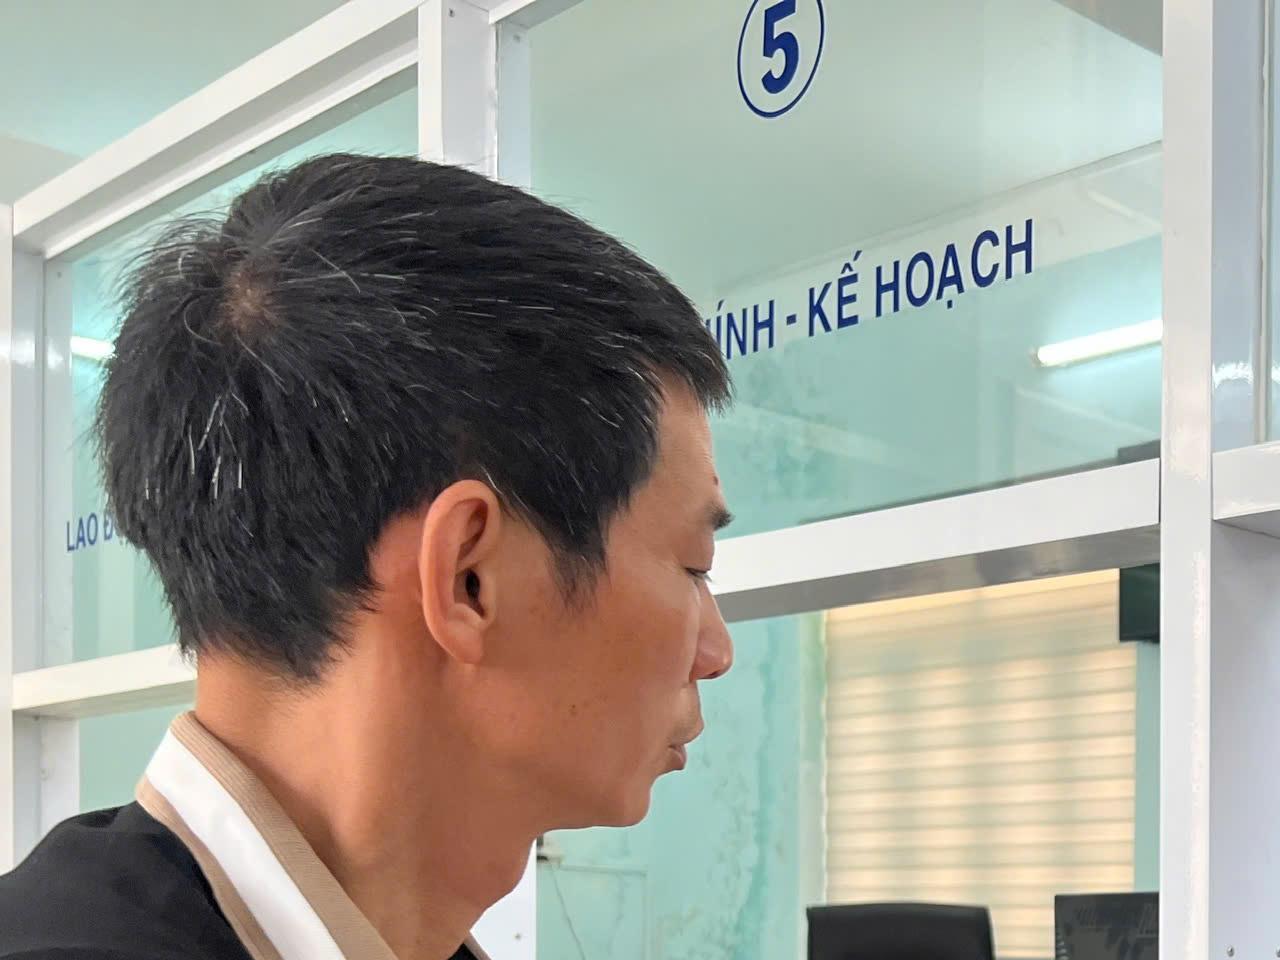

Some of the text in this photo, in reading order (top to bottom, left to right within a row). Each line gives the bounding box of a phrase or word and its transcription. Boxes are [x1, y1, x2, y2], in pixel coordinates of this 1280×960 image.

[762, 0, 799, 94] 5
[808, 250, 862, 337] KẾ
[875, 218, 1033, 318] HOẠCH
[66, 512, 99, 552] LAO
